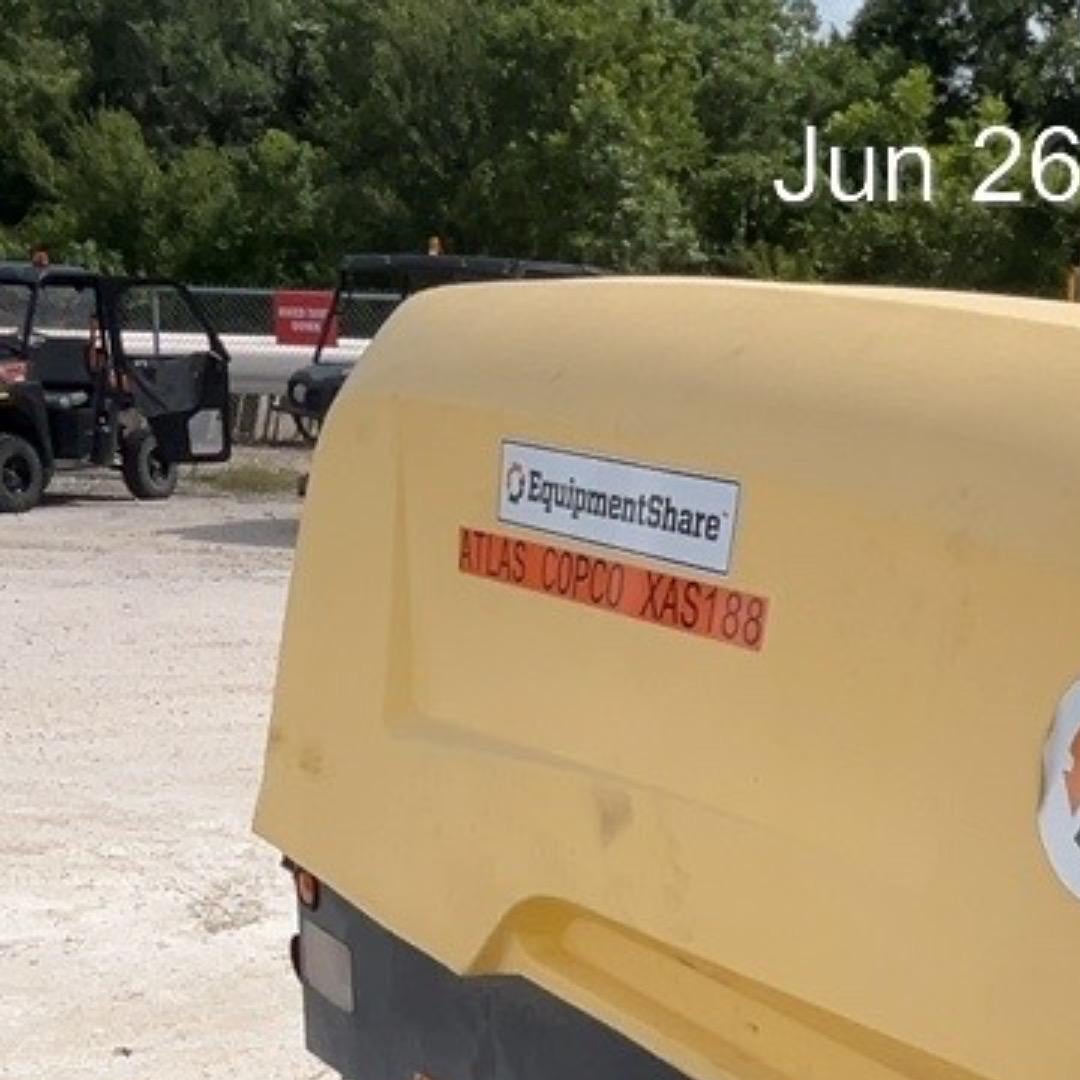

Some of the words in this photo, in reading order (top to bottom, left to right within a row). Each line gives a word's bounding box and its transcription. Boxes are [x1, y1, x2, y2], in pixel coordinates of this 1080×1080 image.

[527, 469, 723, 542] EquipmentShare
[460, 529, 527, 583] ATLAS
[540, 547, 625, 609] COPCO
[638, 570, 764, 647] XAS188
